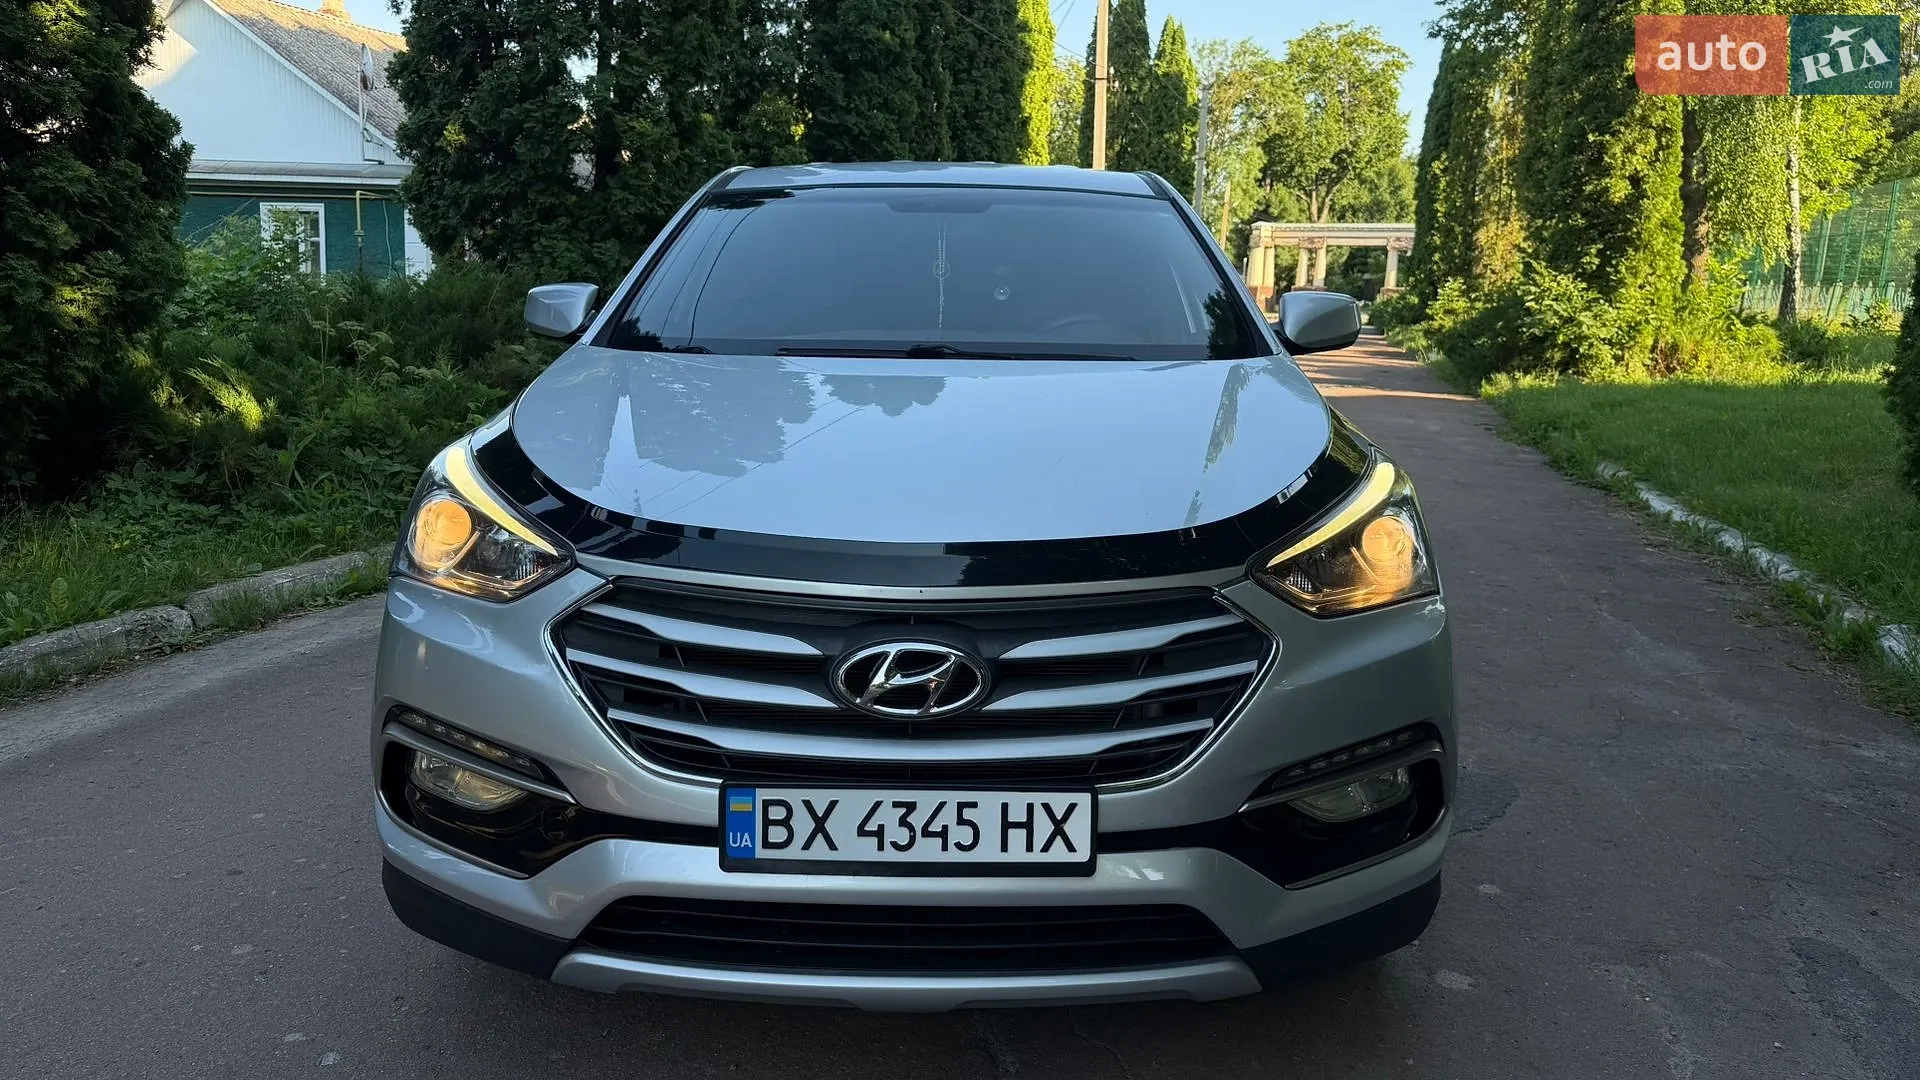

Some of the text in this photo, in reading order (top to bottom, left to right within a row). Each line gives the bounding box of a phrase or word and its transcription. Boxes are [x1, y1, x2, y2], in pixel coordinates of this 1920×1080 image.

[729, 832, 752, 848] UA
[760, 798, 1079, 853] BX 4345 HX
